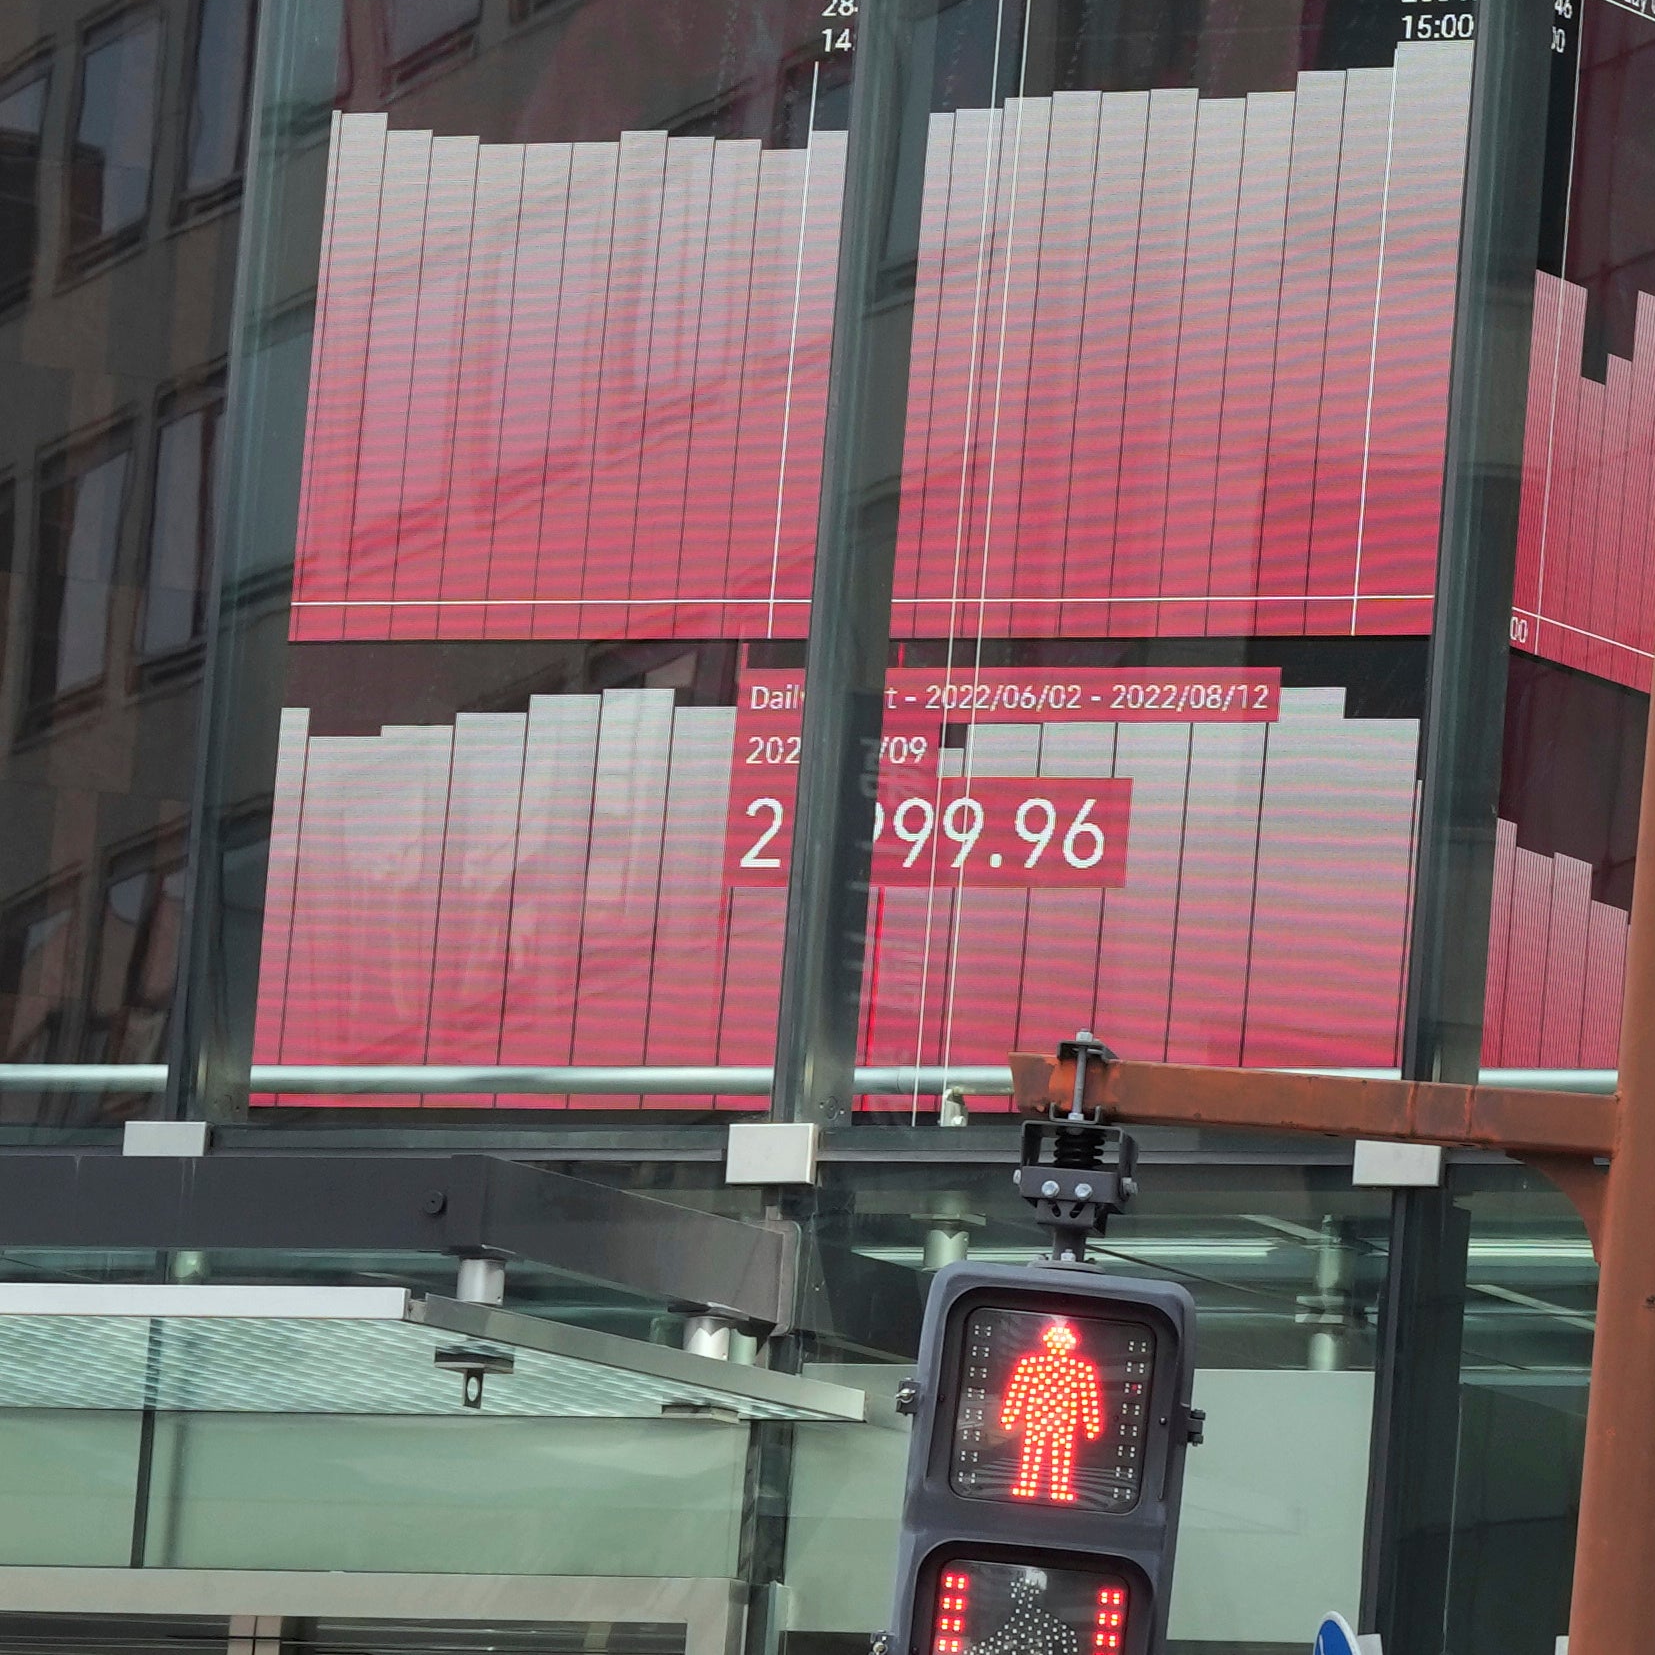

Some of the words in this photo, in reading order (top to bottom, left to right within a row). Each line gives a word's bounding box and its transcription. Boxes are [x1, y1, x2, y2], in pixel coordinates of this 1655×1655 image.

[1400, 13, 1475, 40] 15:00
[750, 684, 806, 710] Dail
[924, 683, 1083, 713] 2022/06/02
[1109, 683, 1269, 713] 2022/08/12
